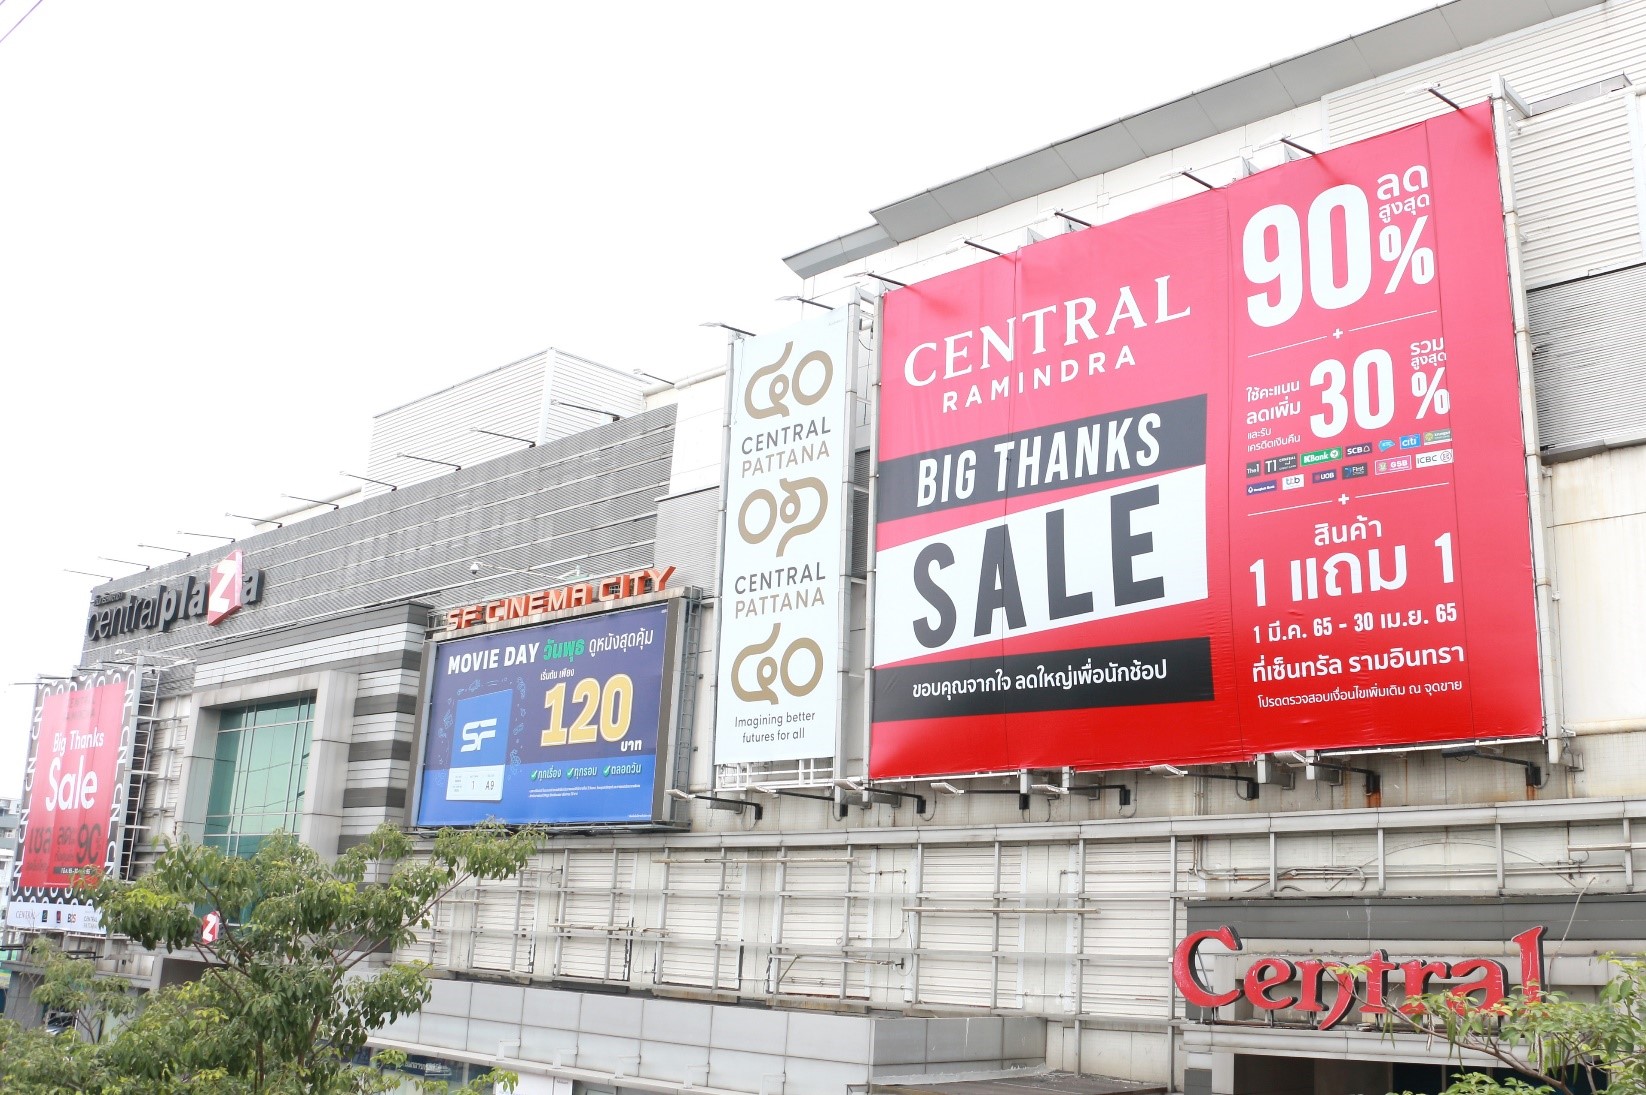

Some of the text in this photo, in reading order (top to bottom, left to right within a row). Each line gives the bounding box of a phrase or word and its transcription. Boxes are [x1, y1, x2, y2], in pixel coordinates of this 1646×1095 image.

[1376, 165, 1429, 200] ลด
[1378, 193, 1430, 223] สูงสุด
[1242, 183, 1435, 328] 90 %
[904, 275, 1191, 387] CENTRAL
[1409, 337, 1444, 356] รวม
[1410, 352, 1447, 370] สูงสุด
[943, 344, 1136, 414] RAMINDRA
[1246, 380, 1300, 403] ใช้คะแนน
[1309, 348, 1395, 439] 30
[1246, 396, 1301, 425] ลดเพิ่ม
[741, 416, 831, 455] CENTRAL
[1247, 434, 1301, 452] เครดิตเงินคืน
[1248, 428, 1271, 440] และรับ
[1402, 437, 1417, 447] citi
[741, 440, 830, 478] PATTANA
[917, 412, 1162, 507] BIG THANKS
[1303, 452, 1329, 463] KBank
[1347, 447, 1363, 455] SCB
[1390, 459, 1408, 468] GSB
[1417, 454, 1437, 464] ICBC
[1320, 472, 1335, 480] UOB
[1314, 514, 1382, 546] สินค้า
[735, 561, 826, 595] CENTRAL
[912, 484, 1165, 649] SALE
[1249, 532, 1454, 607] 1 แถม 1
[446, 565, 676, 631] SF CINEMA CITY
[735, 587, 825, 619] PATTANA
[1253, 625, 1261, 643] 1
[1268, 619, 1307, 642] มี.ค.
[1313, 616, 1333, 637] 65
[1354, 611, 1374, 632] 30
[1381, 608, 1429, 629] เม.ย.
[1435, 602, 1457, 623] 65
[447, 627, 654, 675] MOVIE DAY วันพุธ ดูหนังสุดคุ้ม
[1252, 645, 1465, 683] ที่เซ็นทรัล รามอินทรา
[913, 658, 1167, 700] ขอบคุณจากใจ ลดใหญ่เพื่อนักช้อป
[1257, 680, 1462, 708] โปรดตรวจสอบเงื่อนไขเพิ่มเติม ณ จุดขาย
[540, 673, 634, 747] 120
[735, 711, 816, 729] Imagining better
[52, 727, 105, 757] Big Thanks
[461, 718, 497, 752] SF
[620, 739, 643, 752] บาท
[743, 727, 805, 743] futures for all
[45, 755, 98, 813] Sale
[537, 762, 642, 781] ทุกเรื่อง ทุกรอบ ตลอดวัน
[1173, 925, 1548, 1031] Central
